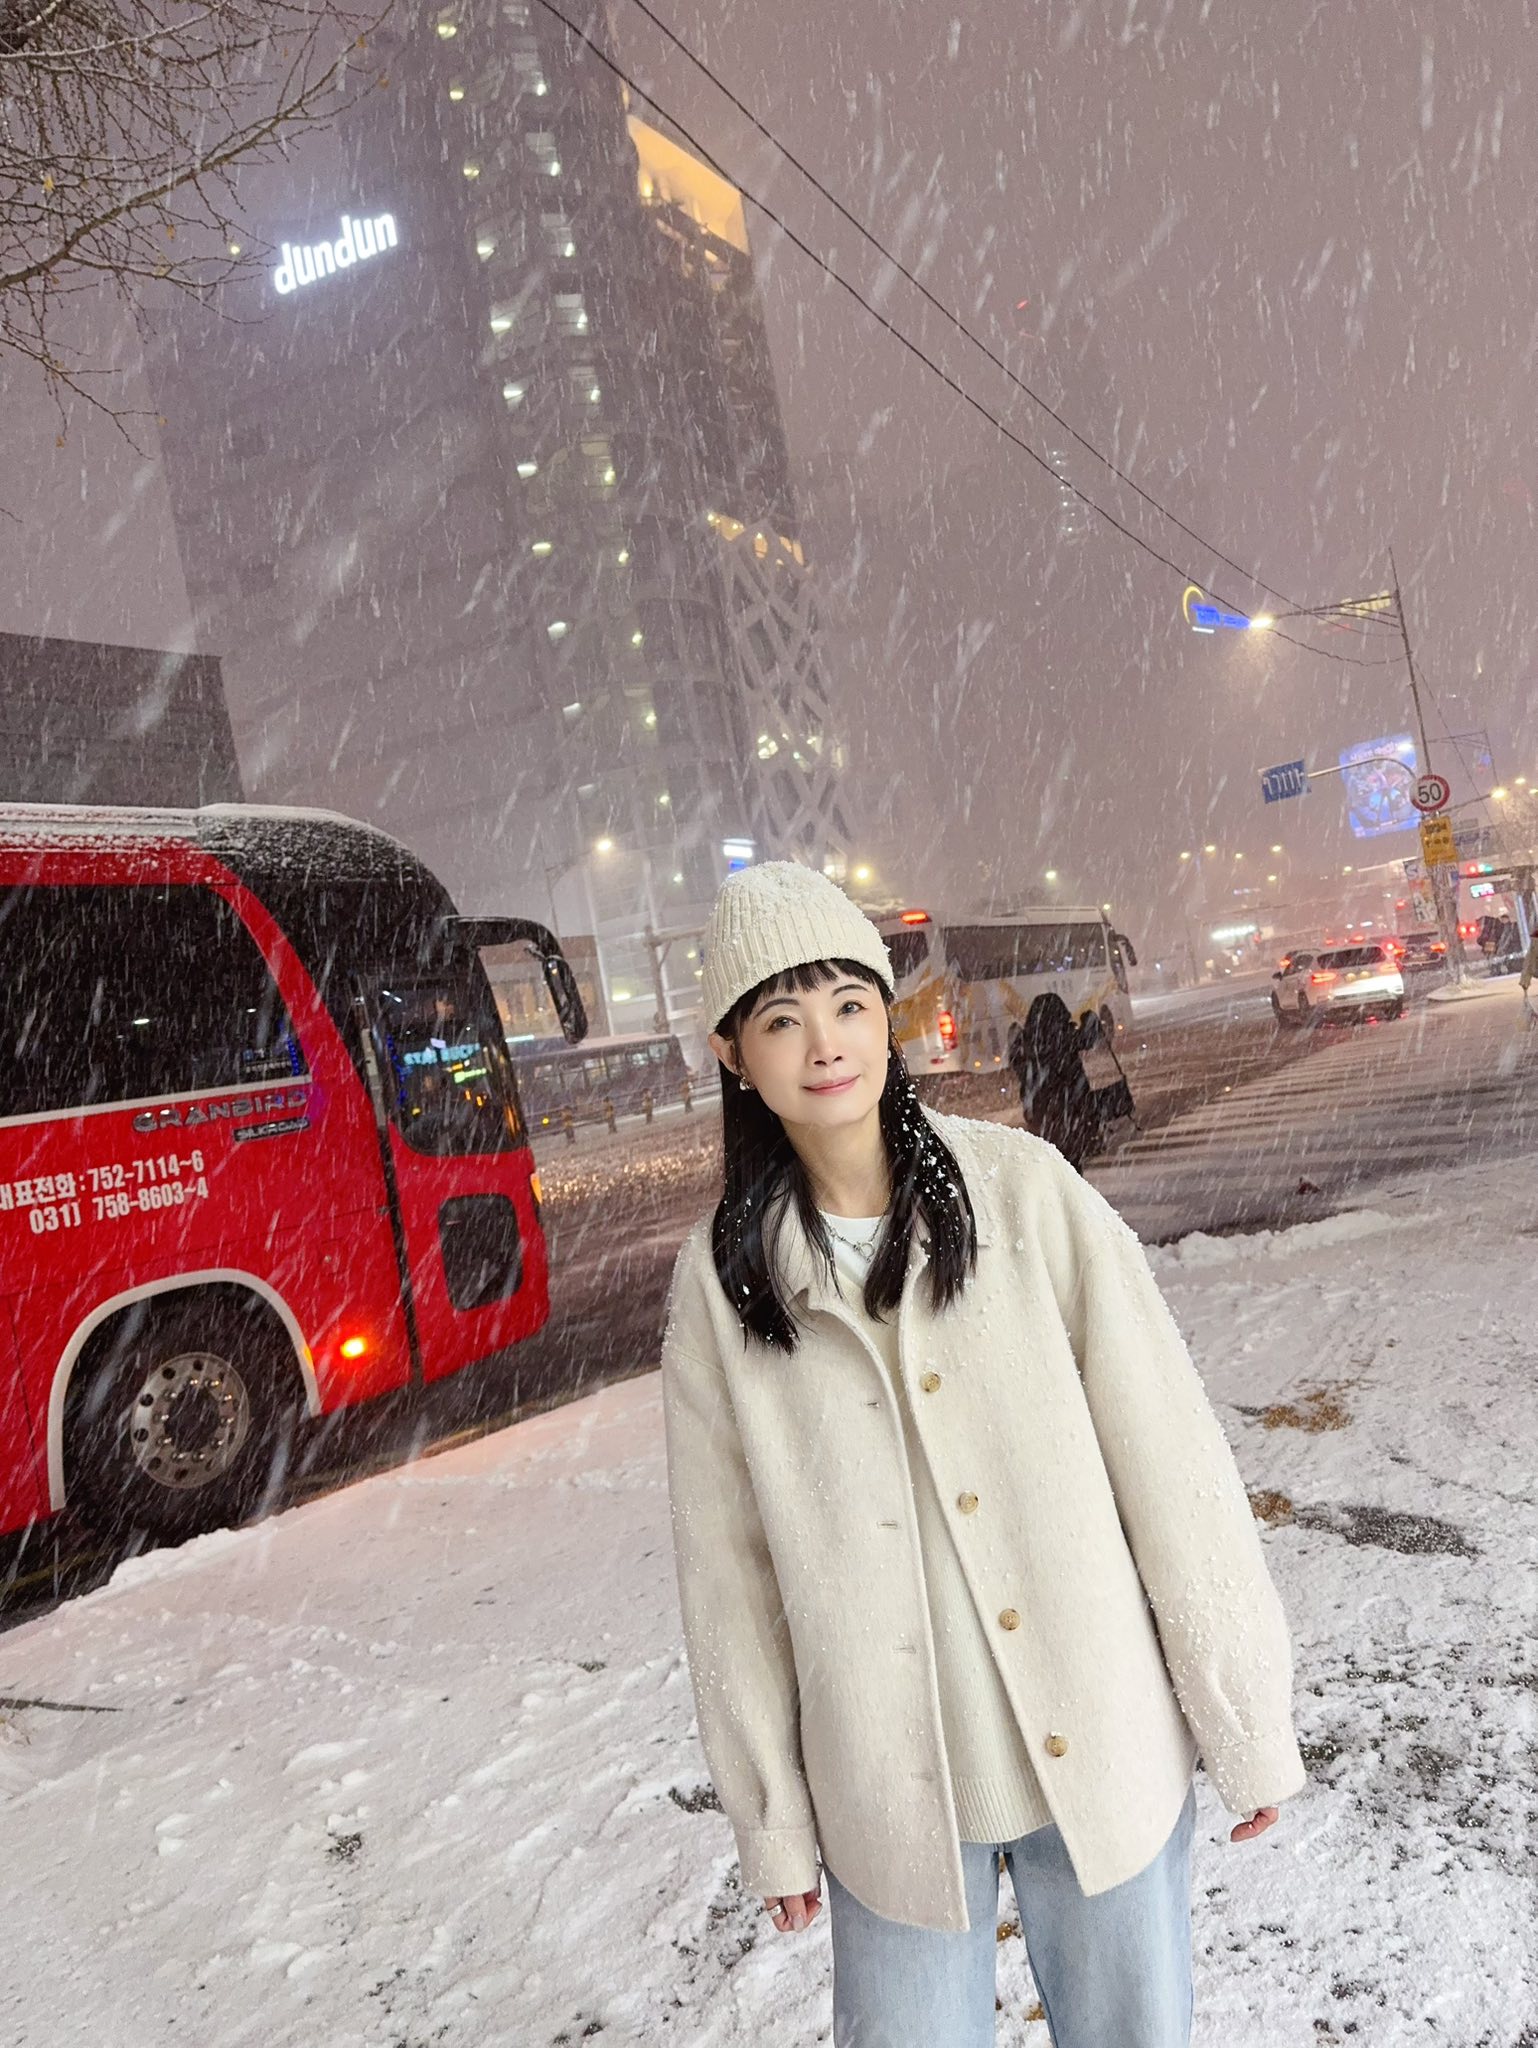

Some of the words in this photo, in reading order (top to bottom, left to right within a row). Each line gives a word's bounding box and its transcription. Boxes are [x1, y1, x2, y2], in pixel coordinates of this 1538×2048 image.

[274, 213, 398, 295] dundun
[1418, 782, 1442, 804] 50
[133, 1089, 308, 1133] GRANBIRD
[92, 1177, 209, 1221] 758-8603~4
